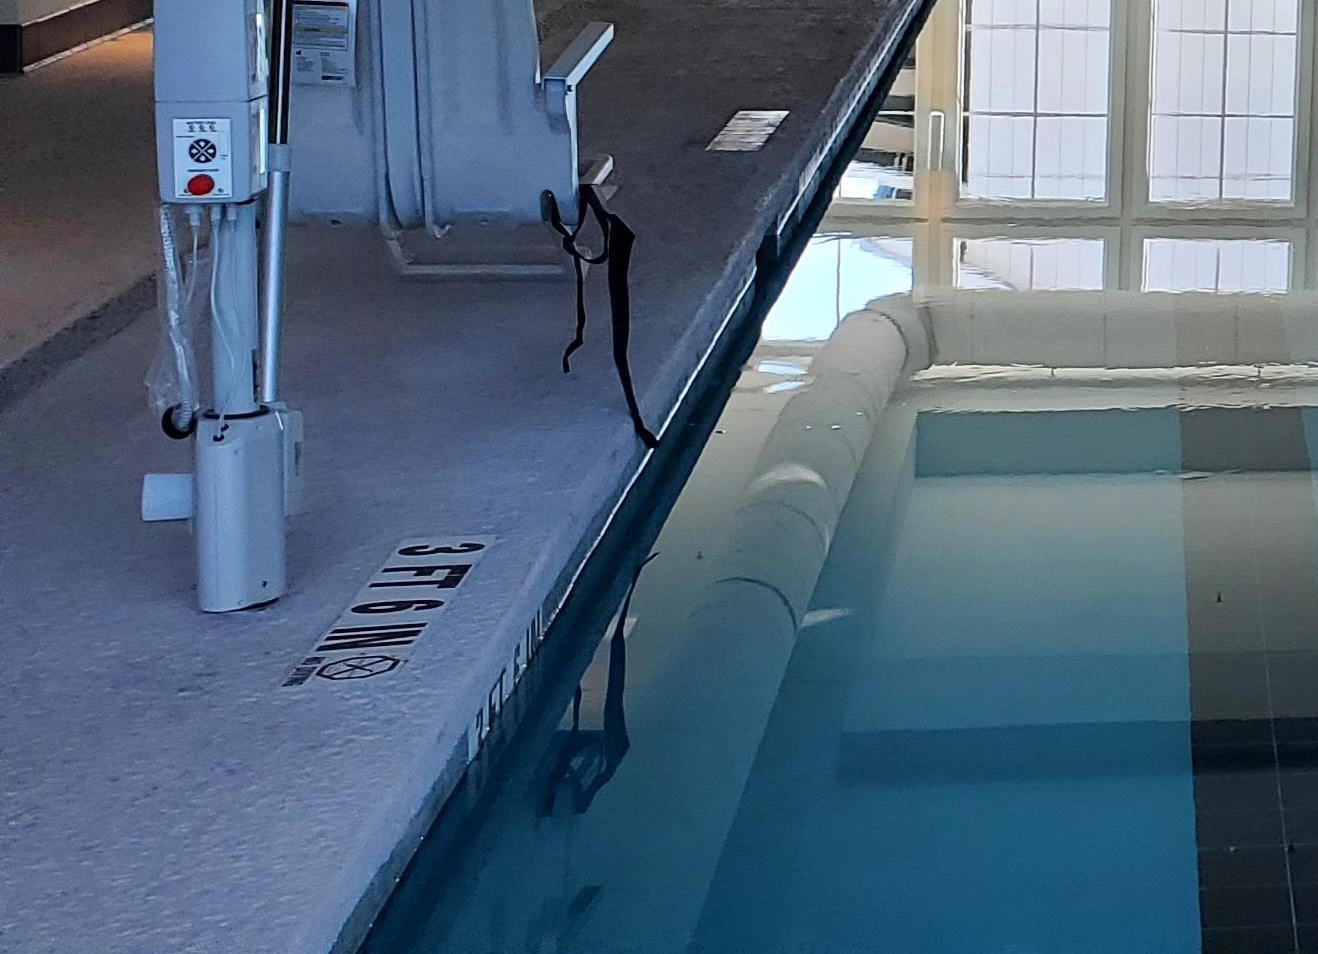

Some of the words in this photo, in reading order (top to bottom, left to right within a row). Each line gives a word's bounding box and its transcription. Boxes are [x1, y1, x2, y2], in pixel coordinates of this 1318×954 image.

[398, 542, 485, 556] 3
[368, 564, 473, 589] FT
[351, 599, 445, 614] 6
[315, 622, 429, 652] IN
